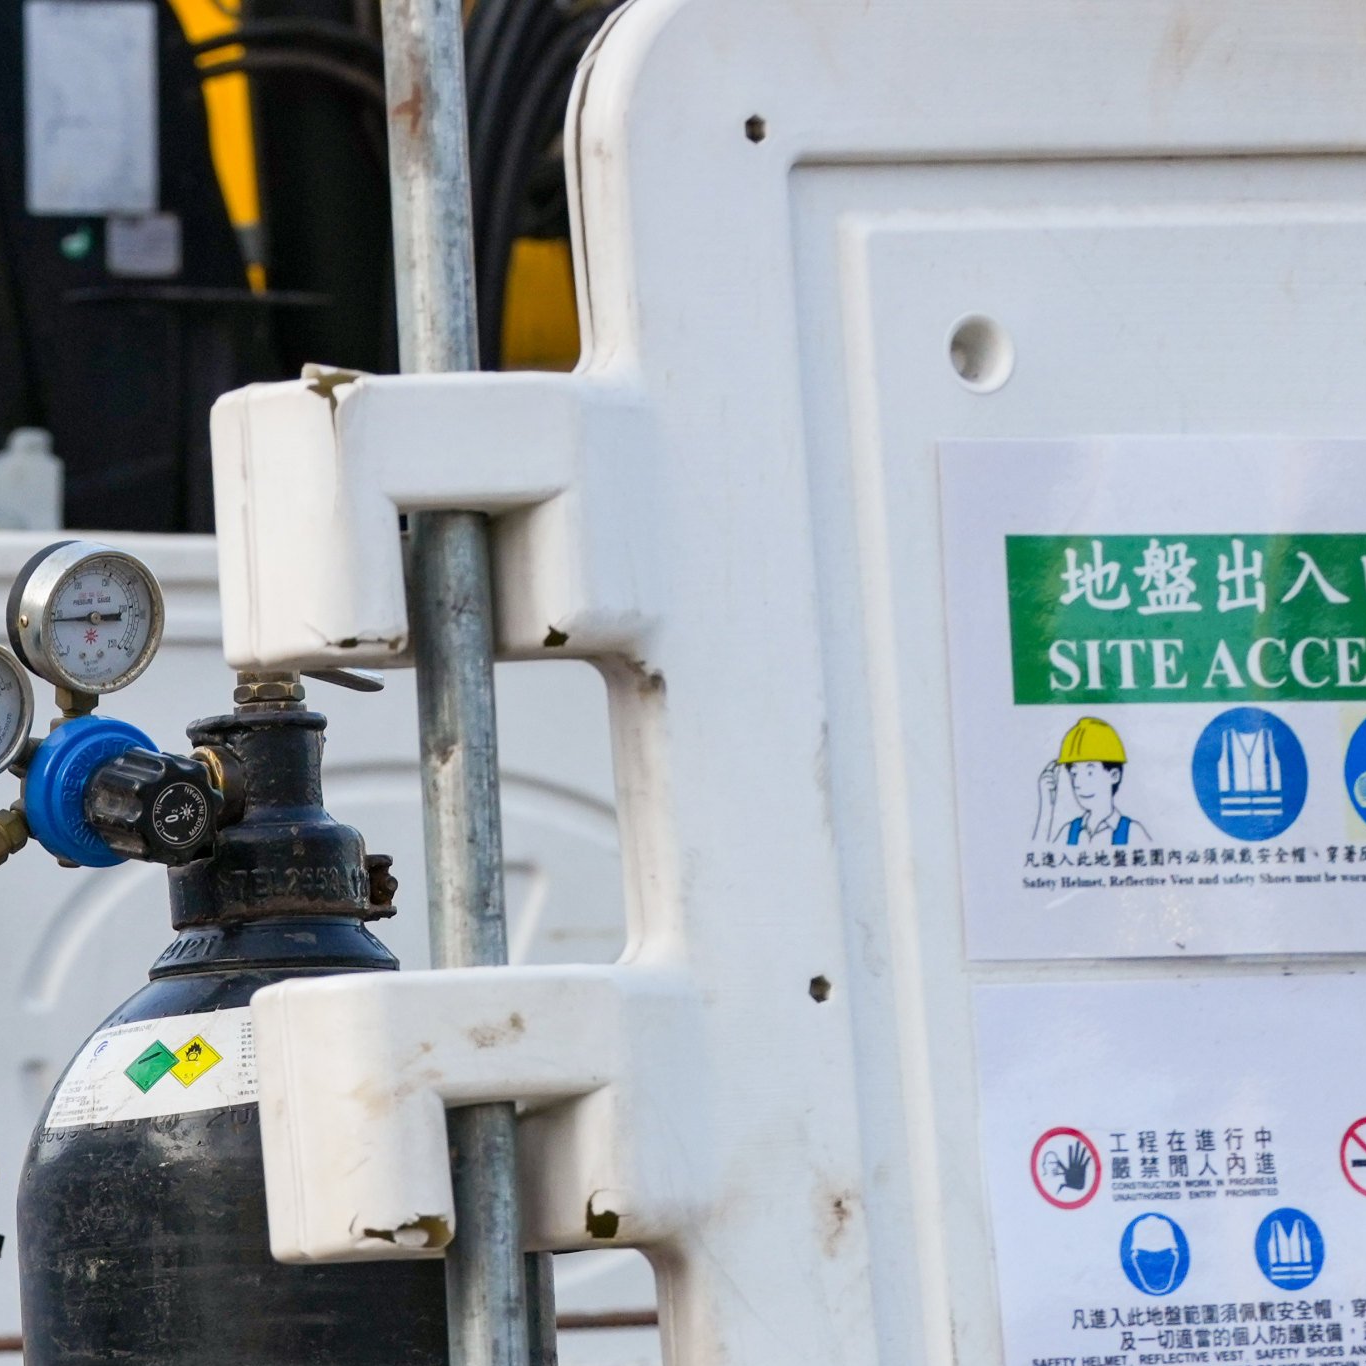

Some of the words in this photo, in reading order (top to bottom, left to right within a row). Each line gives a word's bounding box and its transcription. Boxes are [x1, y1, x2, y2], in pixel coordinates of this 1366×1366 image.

[1048, 638, 1187, 691] SITE
[184, 786, 205, 806] JAPAN
[155, 803, 163, 814] HI
[199, 806, 206, 815] IN
[155, 820, 165, 833] LO
[188, 816, 204, 837] MADE
[1023, 876, 1056, 891] Safety
[1061, 876, 1106, 888] Helmet,
[1110, 875, 1166, 887] Reflective
[1171, 874, 1193, 885] Vest
[1198, 874, 1219, 885] and
[1223, 873, 1255, 886] safety
[1260, 872, 1291, 883] Shoes
[1295, 873, 1321, 883] must
[1325, 871, 1337, 882] be
[1110, 1125, 1273, 1153] 工程在進行中
[1111, 1180, 1181, 1190] CONSTRUCTION
[1185, 1179, 1212, 1188] WORK
[1216, 1178, 1225, 1187] IN
[1229, 1177, 1278, 1186] PROGRESS
[1112, 1192, 1181, 1202] UNAUTHORIZED
[1188, 1190, 1217, 1200] ENTRY
[1225, 1188, 1279, 1198] PROHIBITED
[1140, 1351, 1210, 1365] REFLECTIVE
[1256, 1348, 1299, 1361] SAFETY
[1306, 1346, 1345, 1358] SHOES
